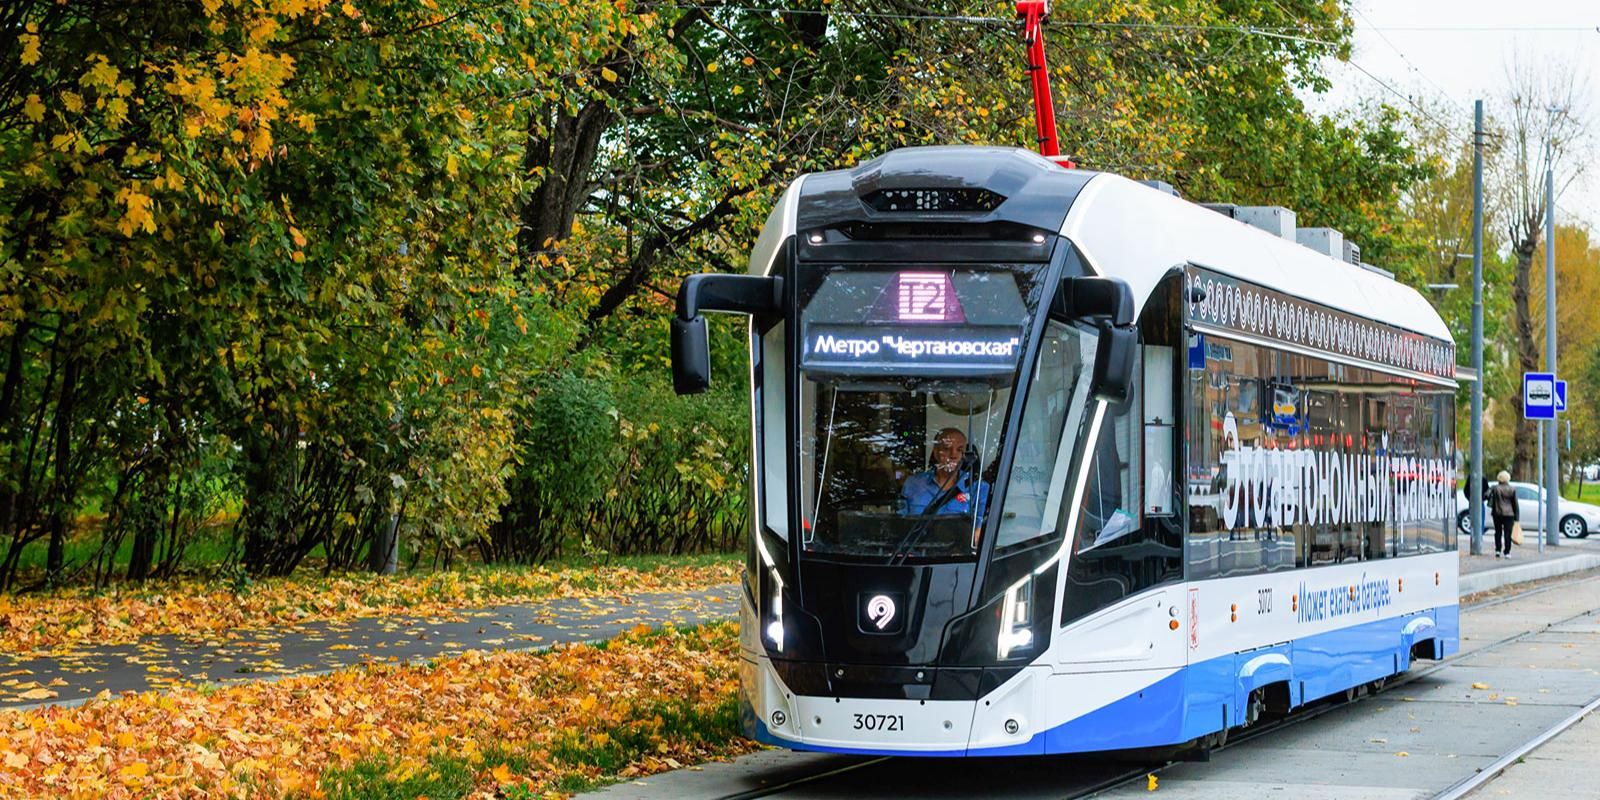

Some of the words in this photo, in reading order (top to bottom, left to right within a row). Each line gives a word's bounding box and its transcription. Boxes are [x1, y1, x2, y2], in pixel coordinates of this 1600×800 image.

[814, 335, 880, 357] Метро
[882, 336, 1019, 358] "Чертановская"
[1222, 411, 1267, 530] Это
[1270, 430, 1390, 527] автономный
[1391, 437, 1456, 544] трамвай
[1257, 588, 1273, 615] 30721
[1298, 580, 1328, 623] Может
[1329, 587, 1351, 617] ехать
[1361, 571, 1391, 617] батарее.
[853, 713, 905, 732] 30721
